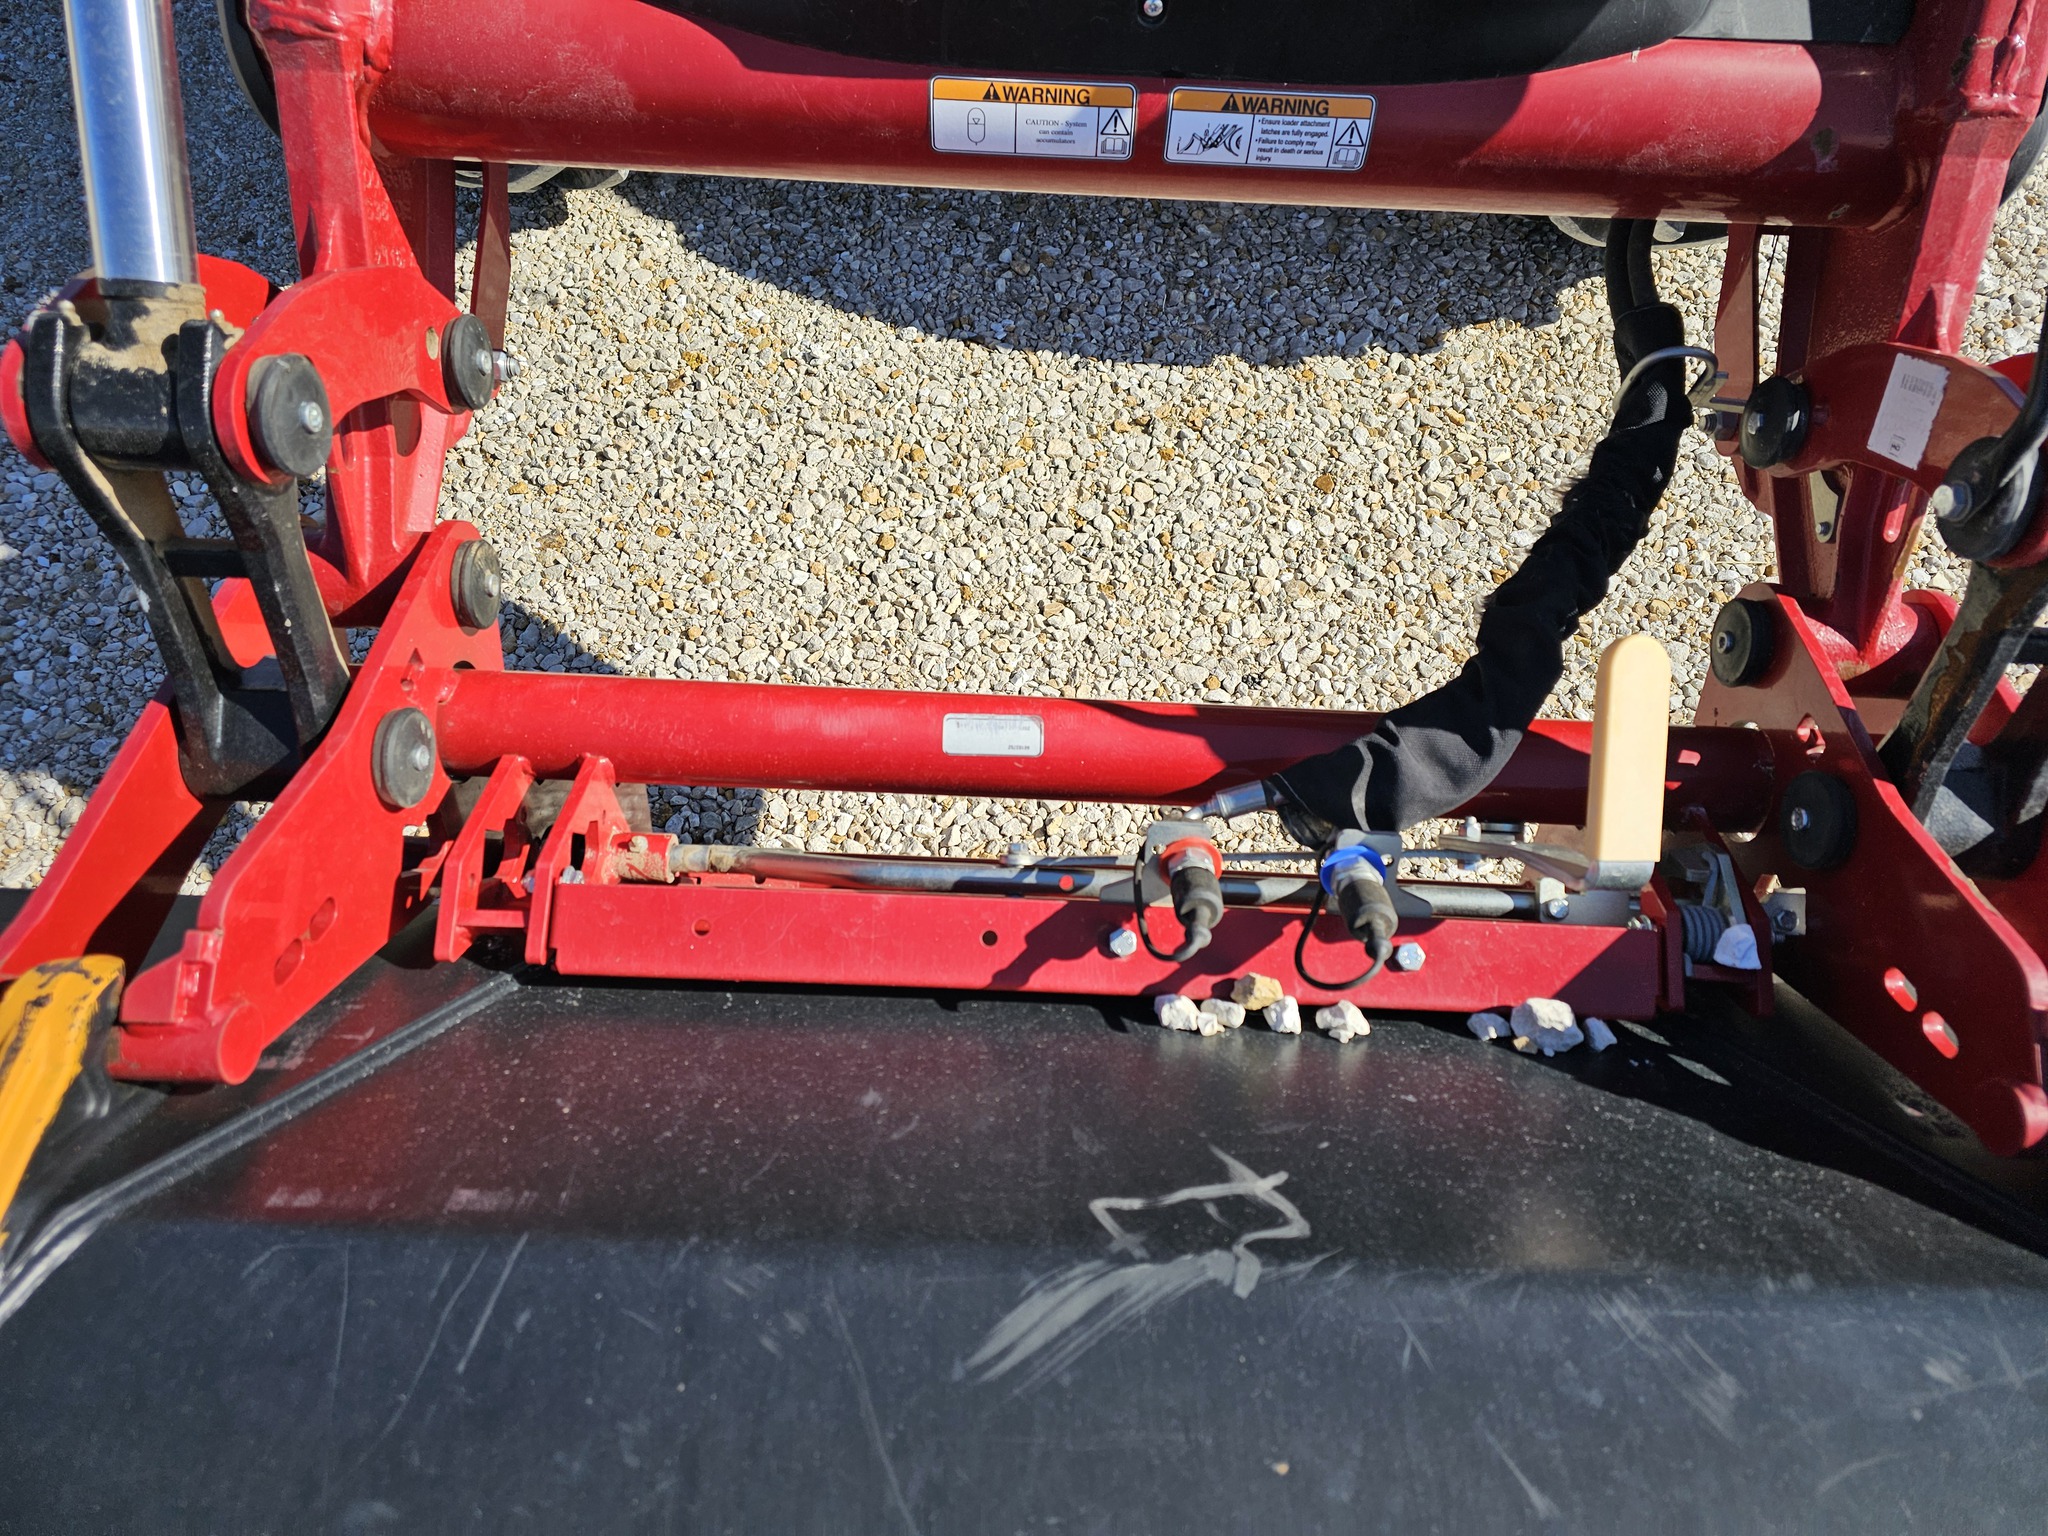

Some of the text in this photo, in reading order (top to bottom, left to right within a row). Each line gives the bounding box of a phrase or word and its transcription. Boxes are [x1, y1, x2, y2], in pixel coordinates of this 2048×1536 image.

[1003, 86, 1090, 105] WARNING
[1242, 96, 1329, 116] WARNING
[1026, 118, 1059, 126] CAUTION
[1065, 120, 1087, 128] System
